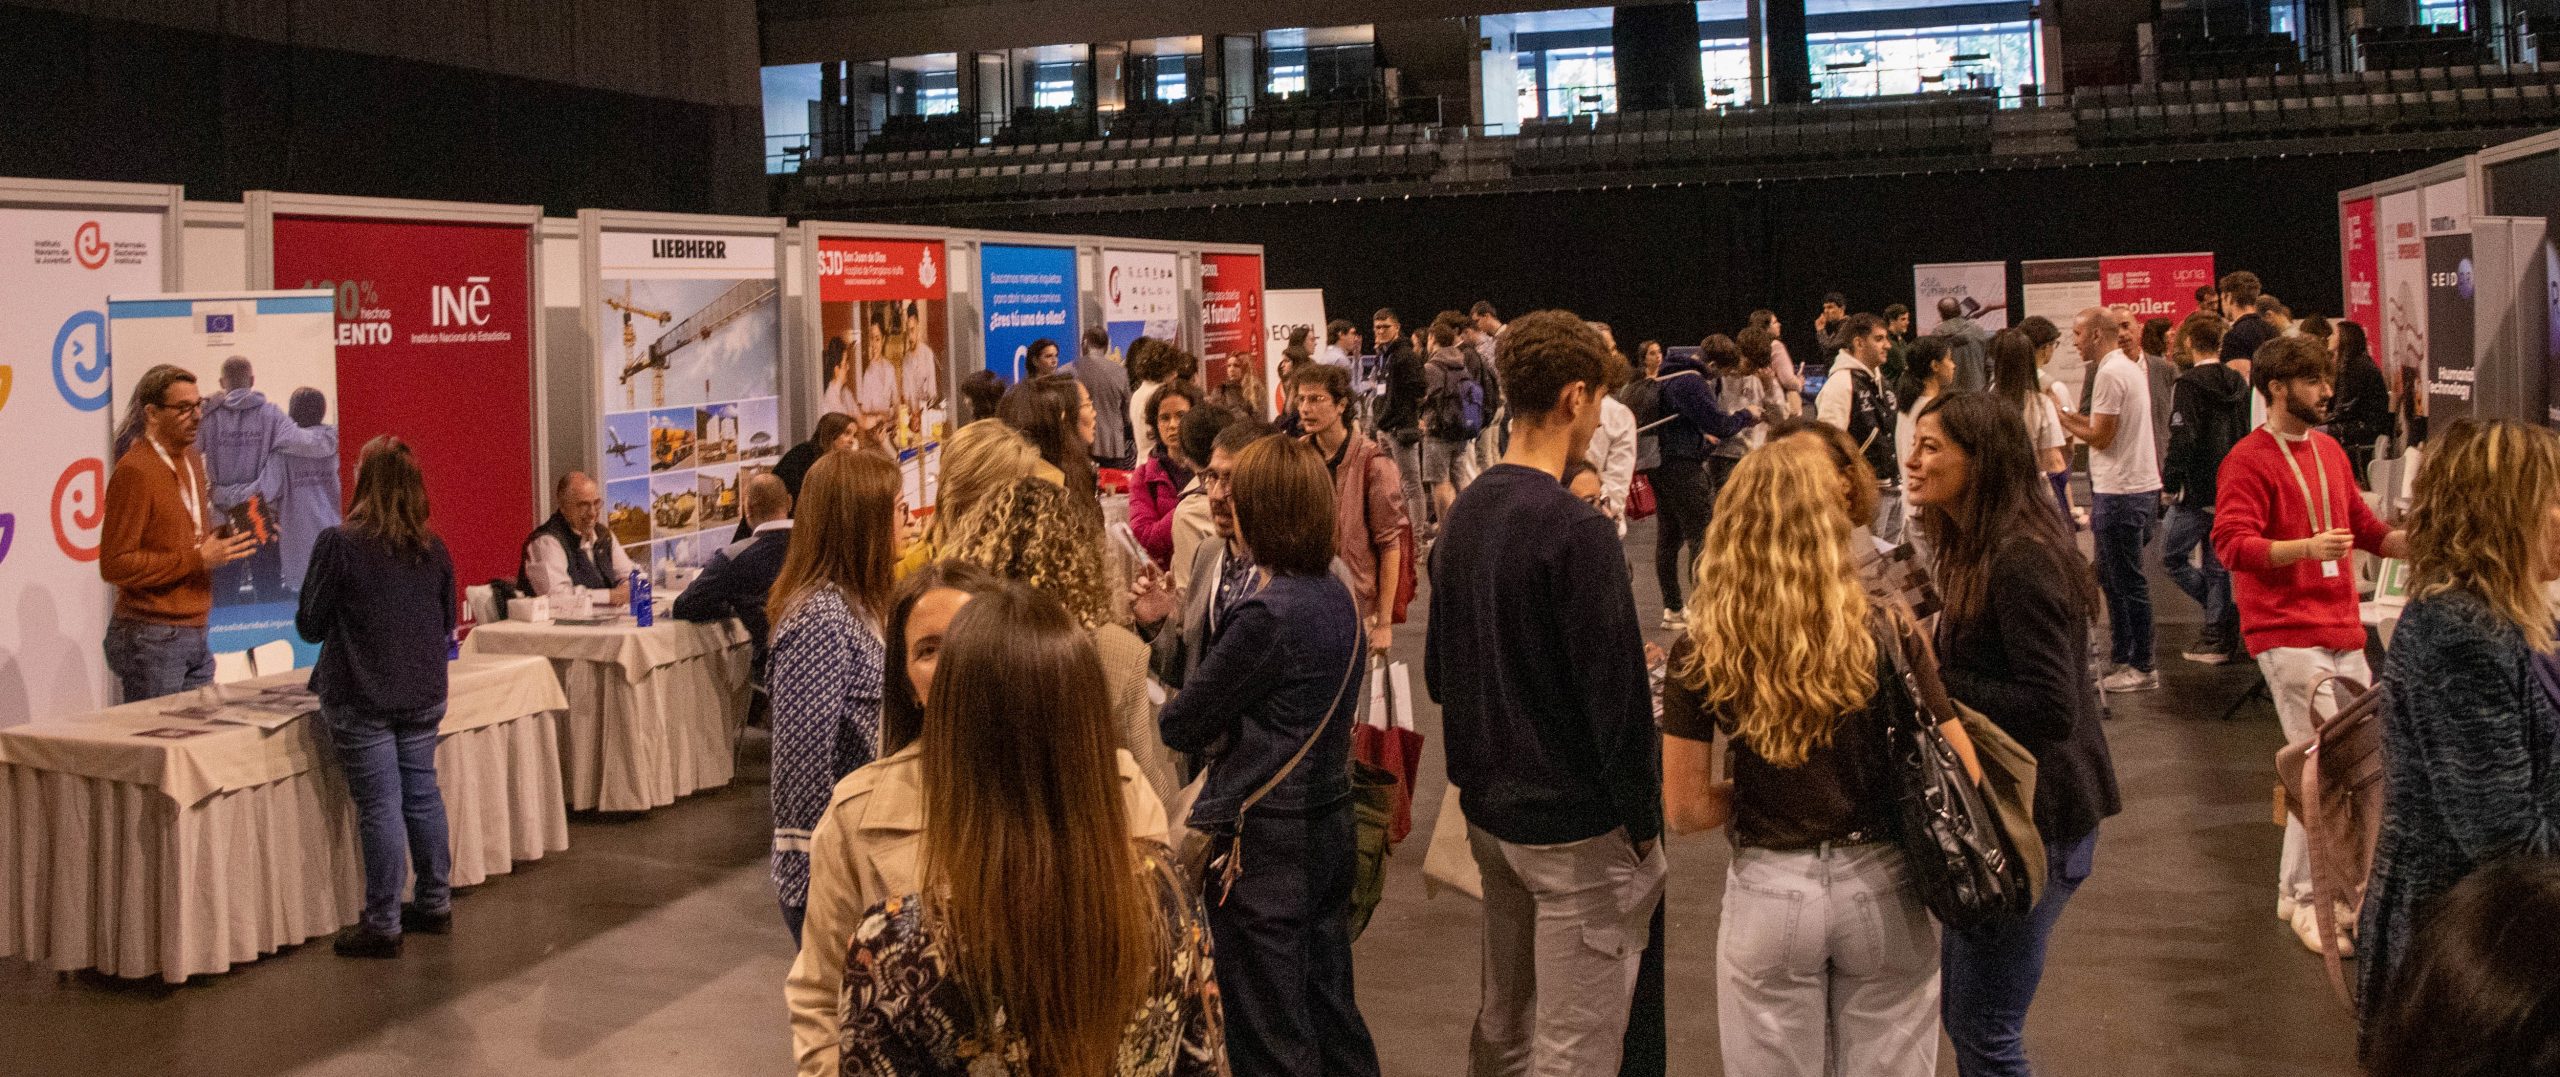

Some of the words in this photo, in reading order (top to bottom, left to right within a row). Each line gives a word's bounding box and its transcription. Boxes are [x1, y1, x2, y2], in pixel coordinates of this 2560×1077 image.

[652, 238, 726, 259] LIEBHERR
[818, 250, 843, 276] SJD
[360, 307, 392, 319] hechos
[410, 333, 438, 344] Instituto
[439, 332, 466, 343] Nacional
[467, 332, 476, 341] de
[477, 331, 512, 341] Estadística
